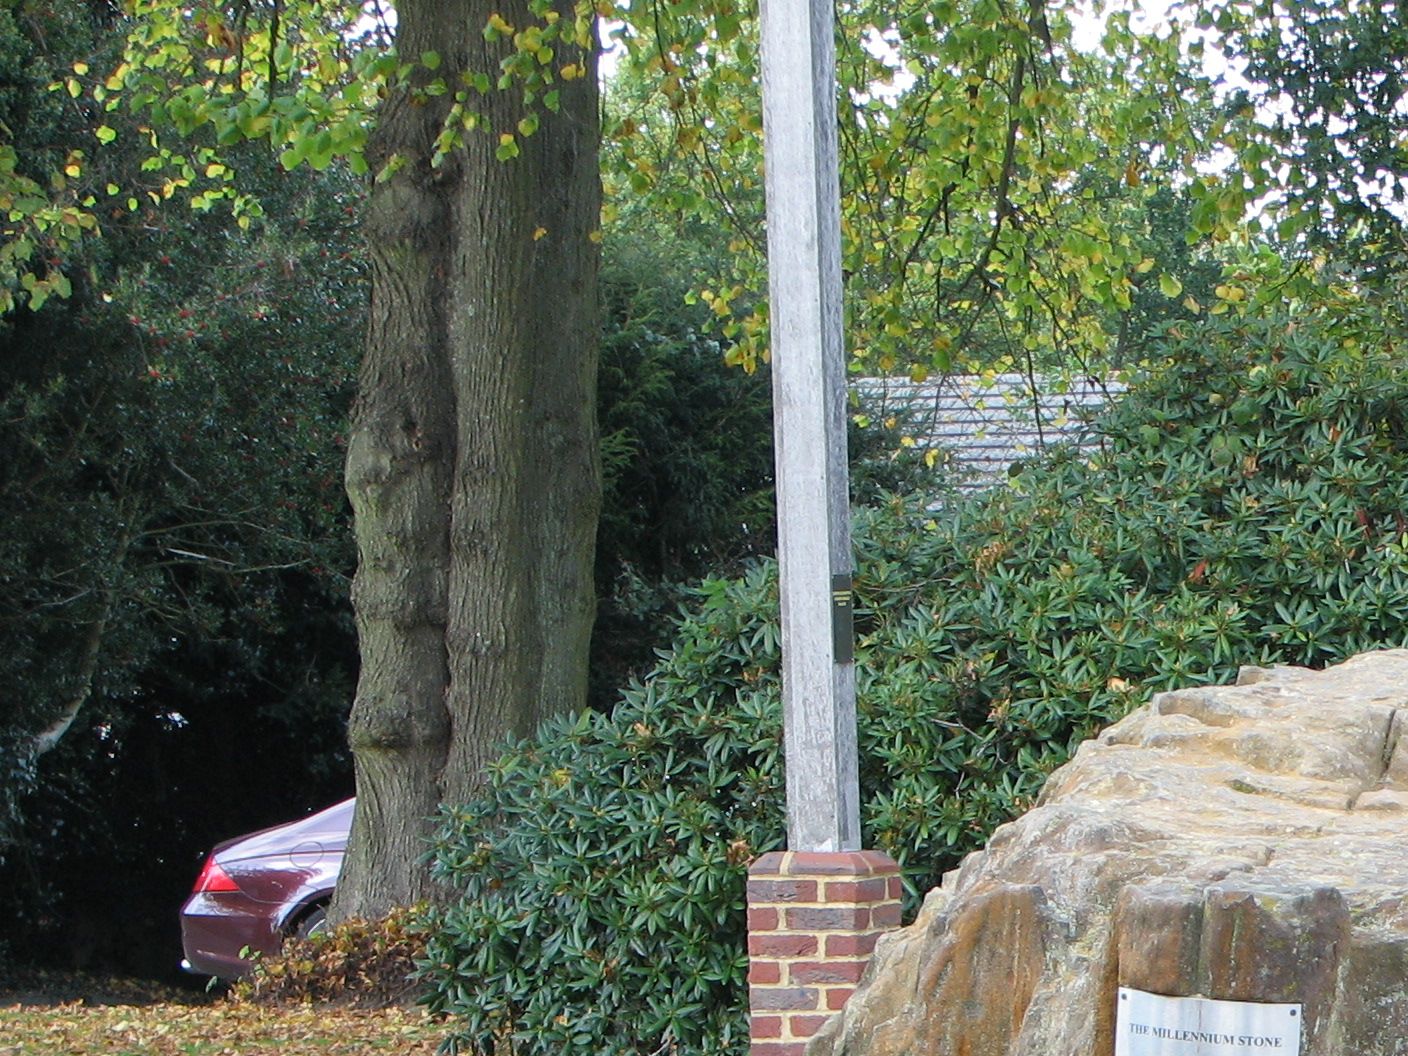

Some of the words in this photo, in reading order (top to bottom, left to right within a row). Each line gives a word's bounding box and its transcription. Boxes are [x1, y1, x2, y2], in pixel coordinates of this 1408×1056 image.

[1129, 1022, 1150, 1035] THE
[1152, 1026, 1234, 1046] MILLENNIUM
[1238, 1035, 1282, 1048] STONE
